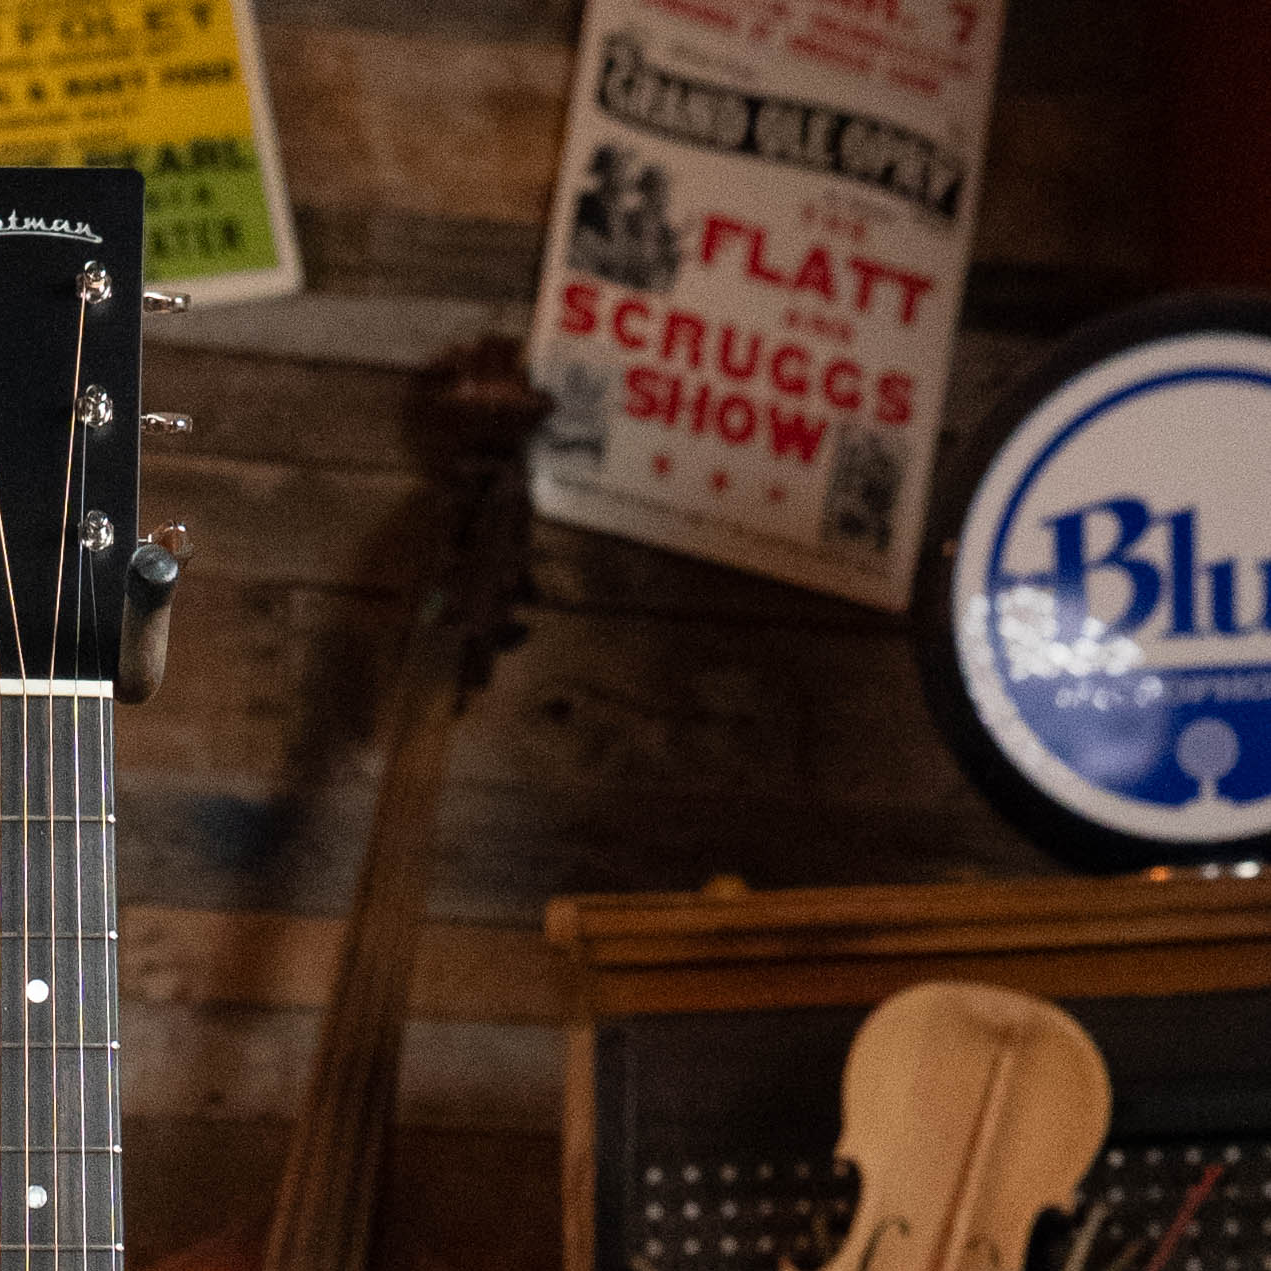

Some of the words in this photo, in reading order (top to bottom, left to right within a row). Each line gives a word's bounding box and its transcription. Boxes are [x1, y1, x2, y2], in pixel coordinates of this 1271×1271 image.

[698, 212, 934, 327] FLATT
[559, 280, 916, 427] SCRUGGS
[623, 366, 828, 466] SHOW
